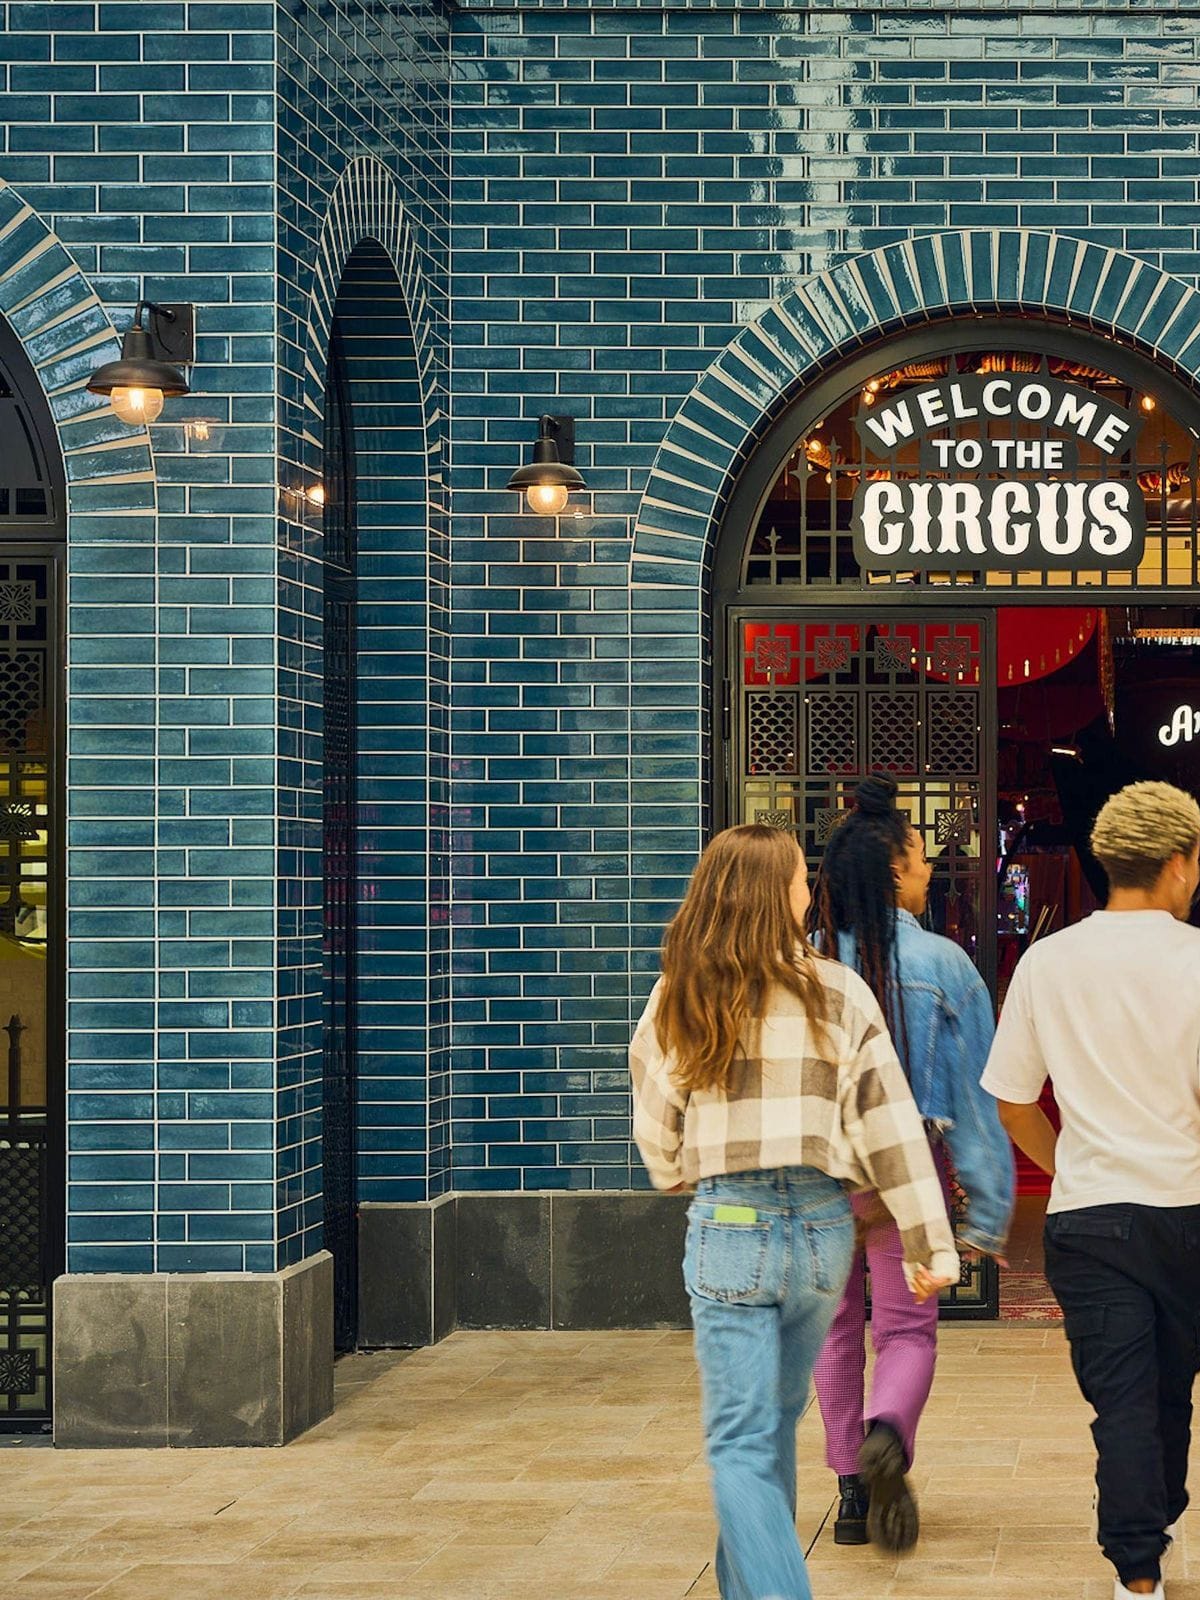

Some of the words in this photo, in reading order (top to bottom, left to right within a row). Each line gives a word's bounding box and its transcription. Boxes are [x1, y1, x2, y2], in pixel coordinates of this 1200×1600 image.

[865, 380, 1130, 454] WELCOME
[932, 439, 983, 468] TO
[991, 439, 1063, 469] THE
[860, 481, 1133, 555] CIRCUS
